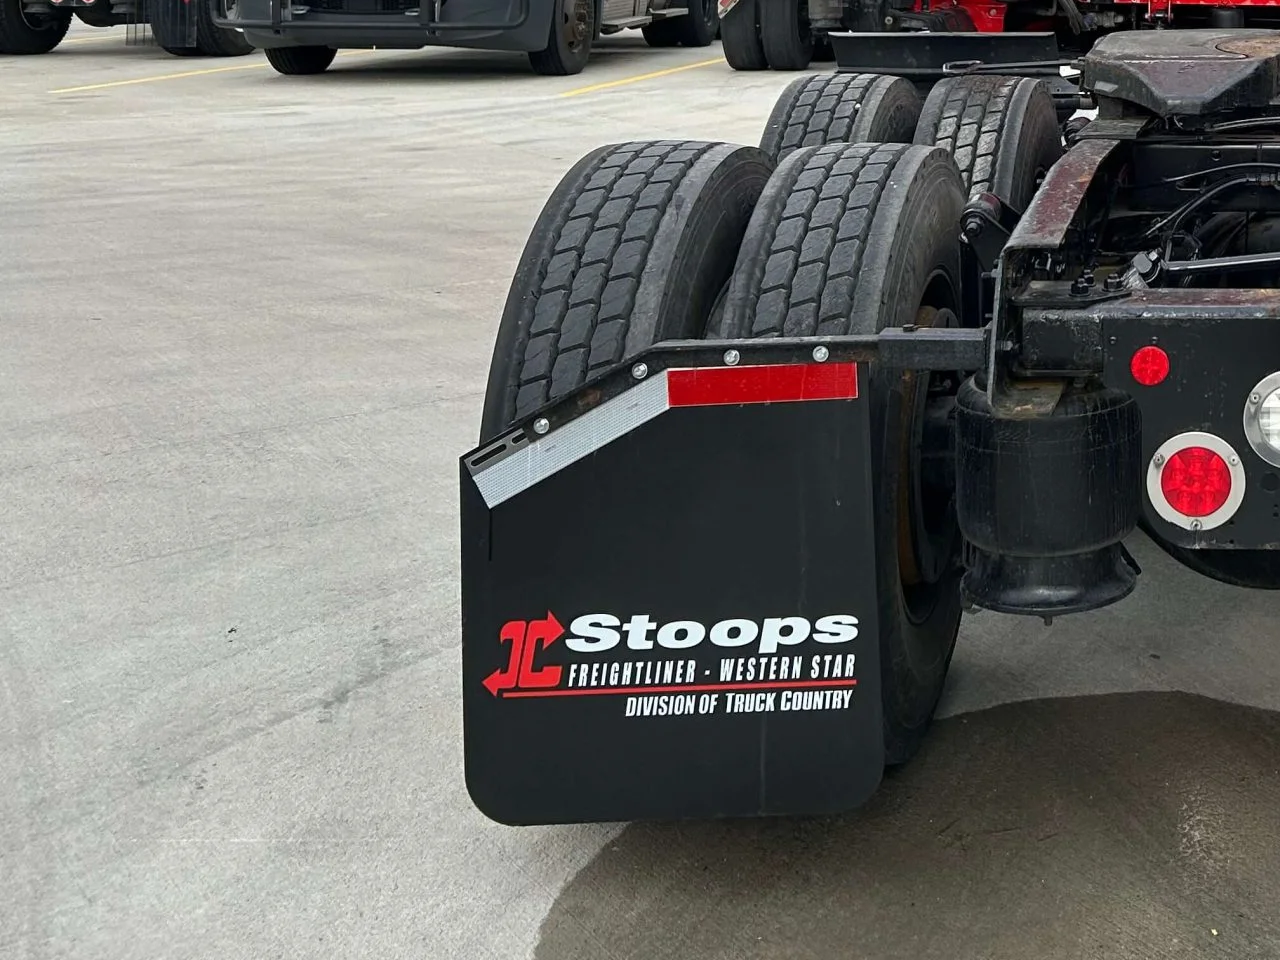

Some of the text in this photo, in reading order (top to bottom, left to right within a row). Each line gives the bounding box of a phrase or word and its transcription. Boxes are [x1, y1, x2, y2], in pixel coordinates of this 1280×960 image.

[565, 613, 859, 654] Stoops
[568, 660, 696, 688] FREIGHTLINER
[720, 655, 802, 682] WESTERN
[811, 654, 856, 679] STAR
[625, 689, 853, 717] DIVISION OF TRUCK COUNTRY
